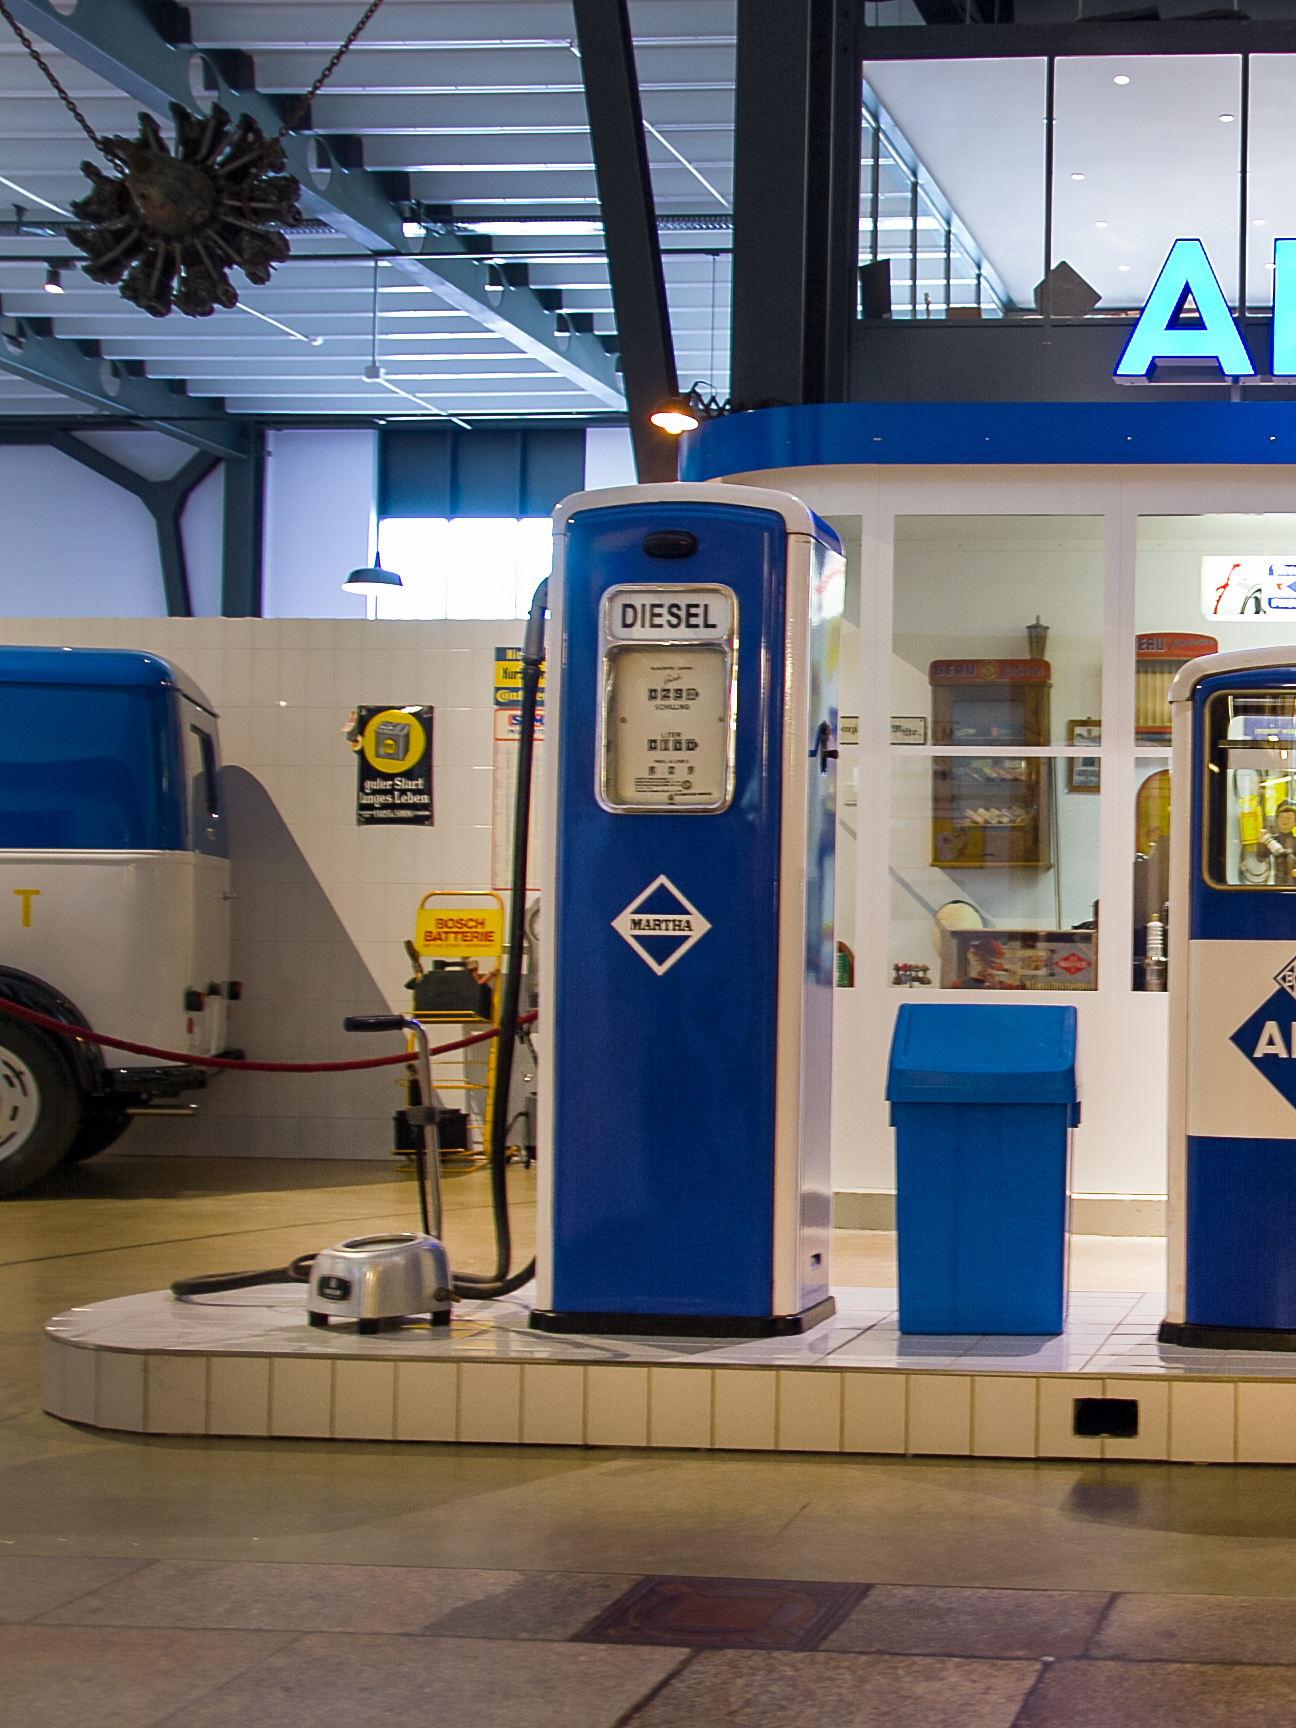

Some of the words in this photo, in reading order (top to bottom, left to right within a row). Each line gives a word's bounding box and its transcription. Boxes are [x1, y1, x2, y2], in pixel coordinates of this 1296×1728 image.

[620, 602, 718, 629] DIESEL
[1134, 637, 1165, 652] ERU
[393, 777, 425, 790] Start
[393, 791, 431, 804] Leben
[13, 888, 40, 928] T
[435, 917, 486, 930] BOSCH
[629, 918, 693, 932] MARTHA
[423, 930, 495, 943] BATTERIE
